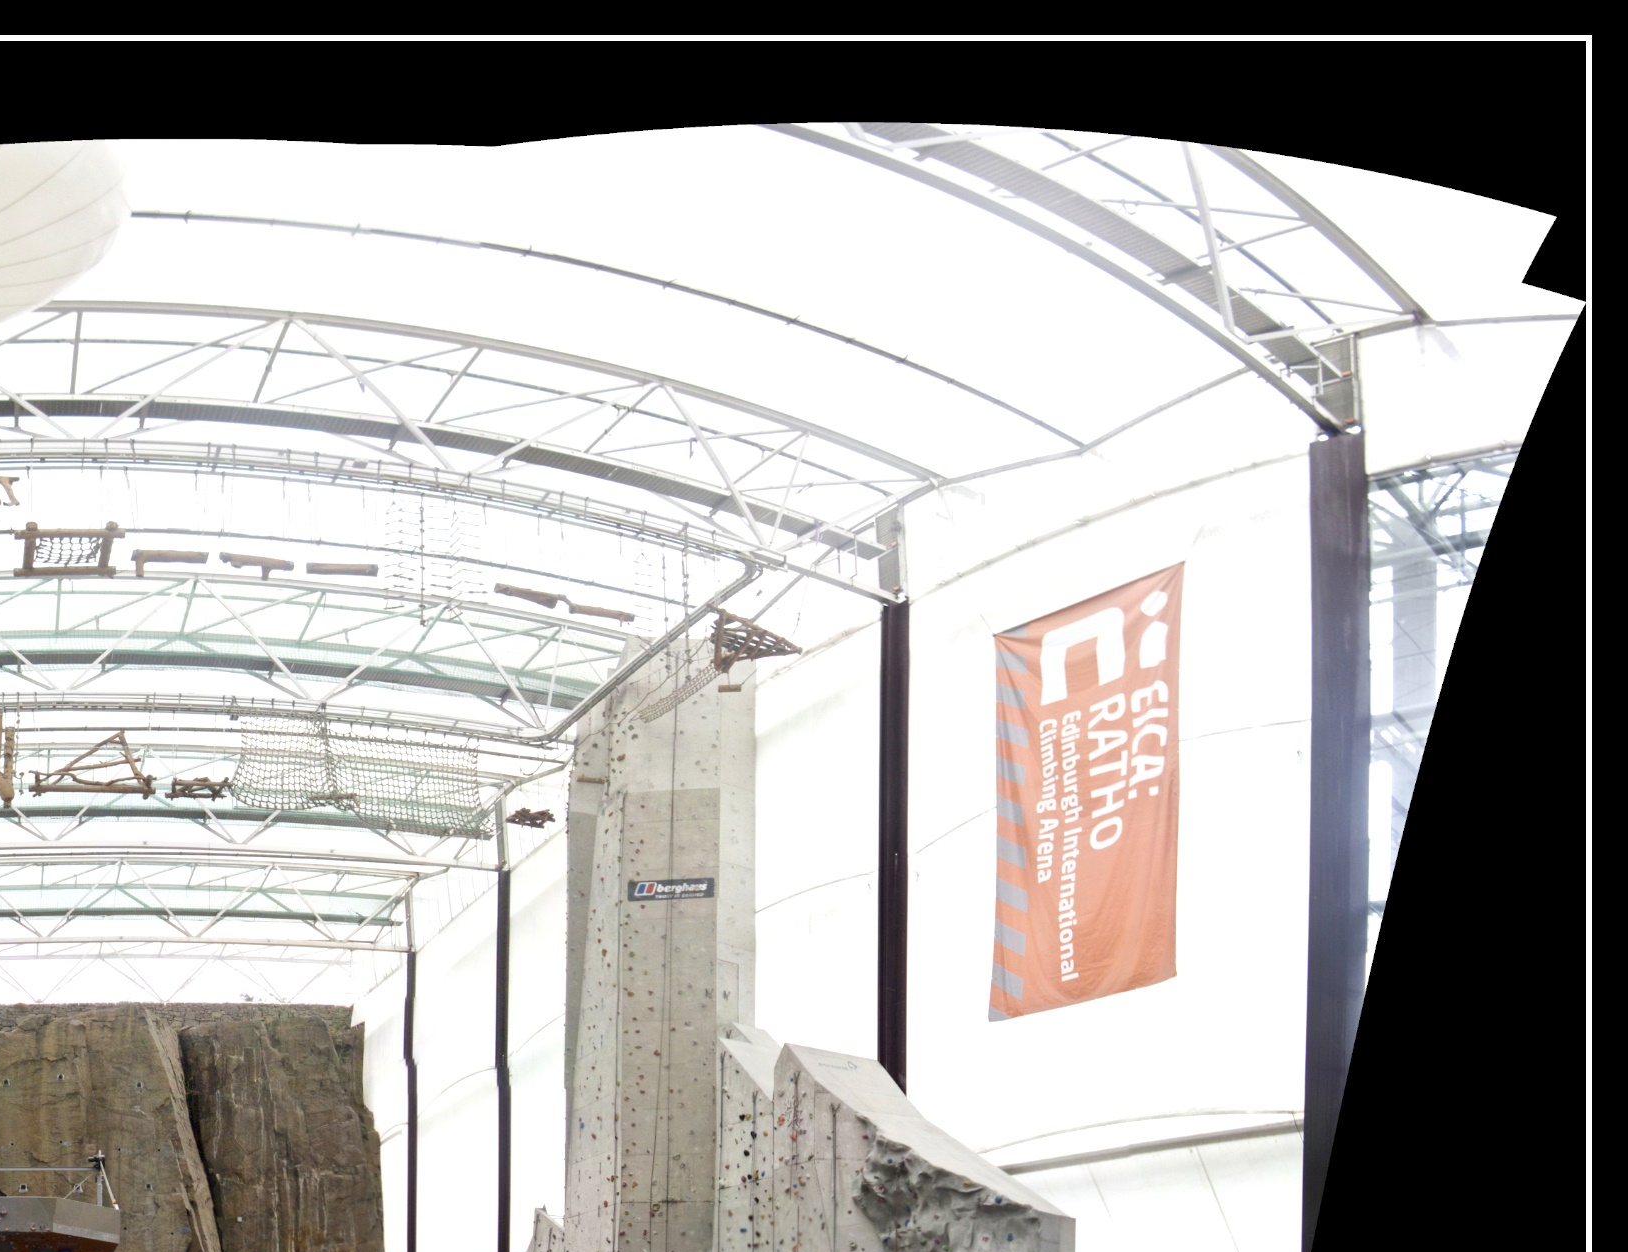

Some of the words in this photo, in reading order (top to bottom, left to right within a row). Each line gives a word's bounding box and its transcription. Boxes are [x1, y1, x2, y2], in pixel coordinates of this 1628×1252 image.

[1036, 718, 1059, 813] Climbing
[1060, 710, 1083, 824] Edinburgh
[1087, 692, 1129, 850] RATHO
[1128, 679, 1169, 800] EICA:
[657, 883, 708, 893] berghaus
[1036, 819, 1060, 883] Arena
[1058, 827, 1083, 982] International
